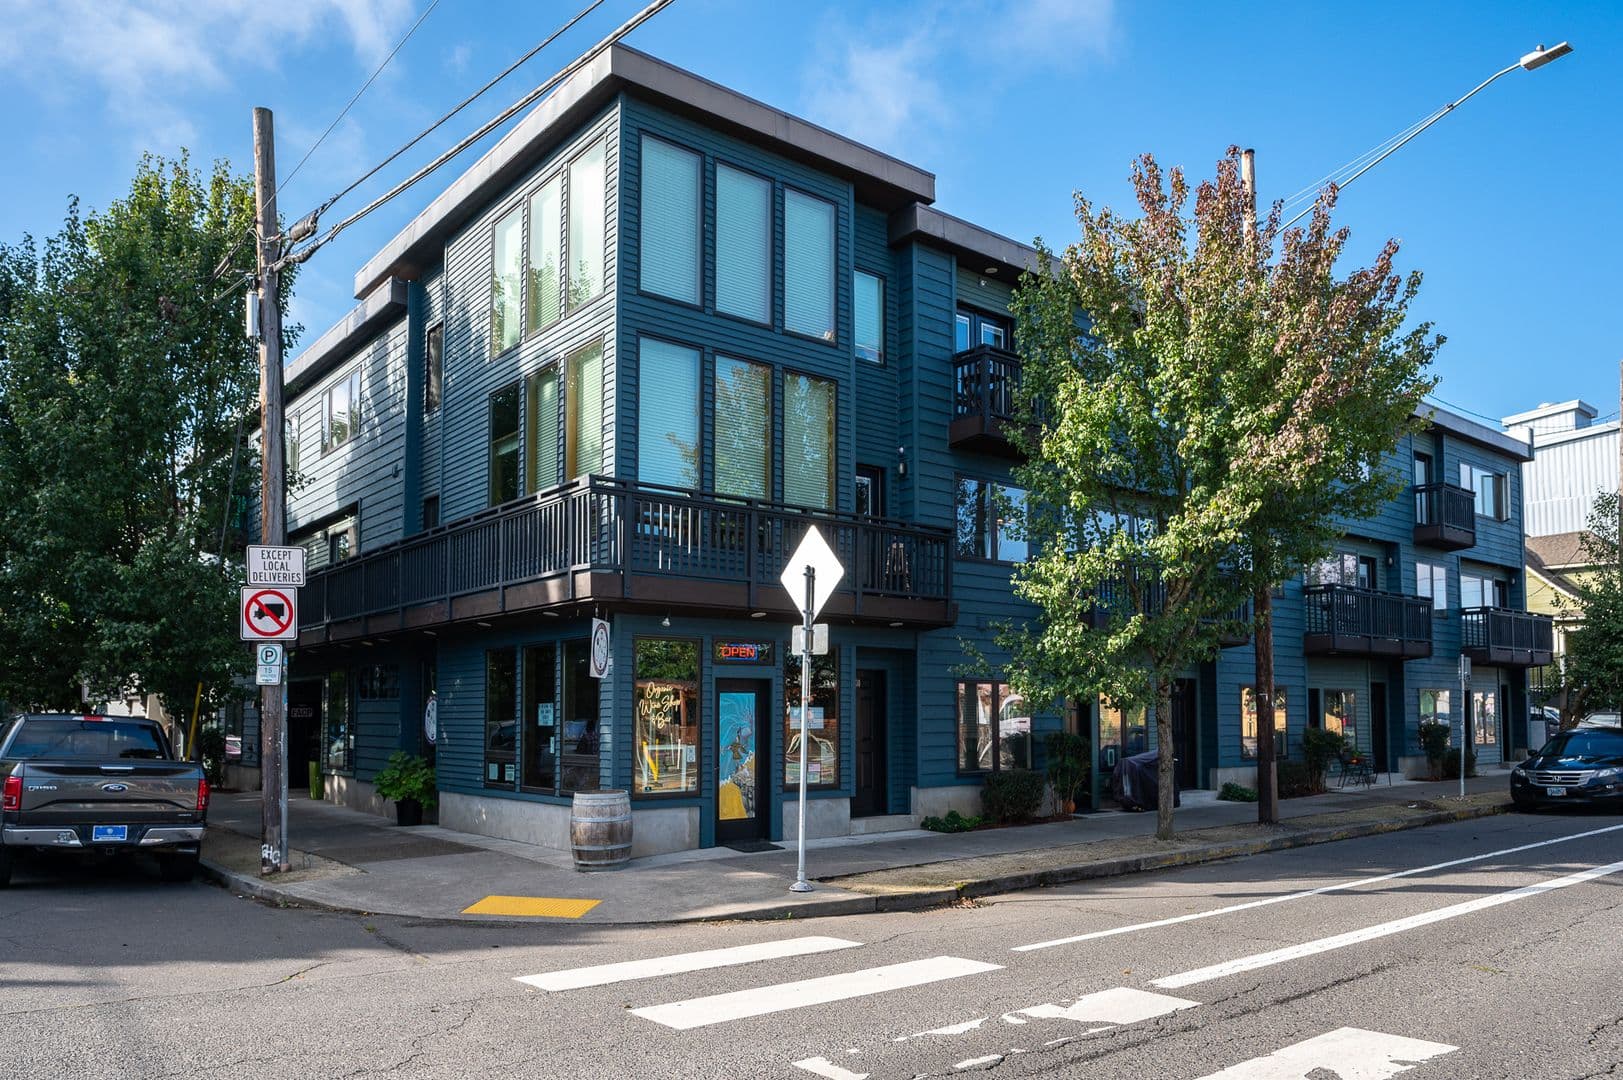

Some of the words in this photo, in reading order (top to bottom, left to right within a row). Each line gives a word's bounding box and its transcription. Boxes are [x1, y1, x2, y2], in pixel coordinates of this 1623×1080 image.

[261, 549, 292, 560] EXCEPT
[263, 561, 290, 571] LOCAL
[252, 571, 301, 583] DELIVERIES
[265, 650, 273, 660] P
[721, 646, 755, 657] OPEN
[647, 682, 673, 698] Organic
[639, 699, 661, 715] Wine
[662, 695, 681, 712] Shop
[656, 712, 671, 729] Bar
